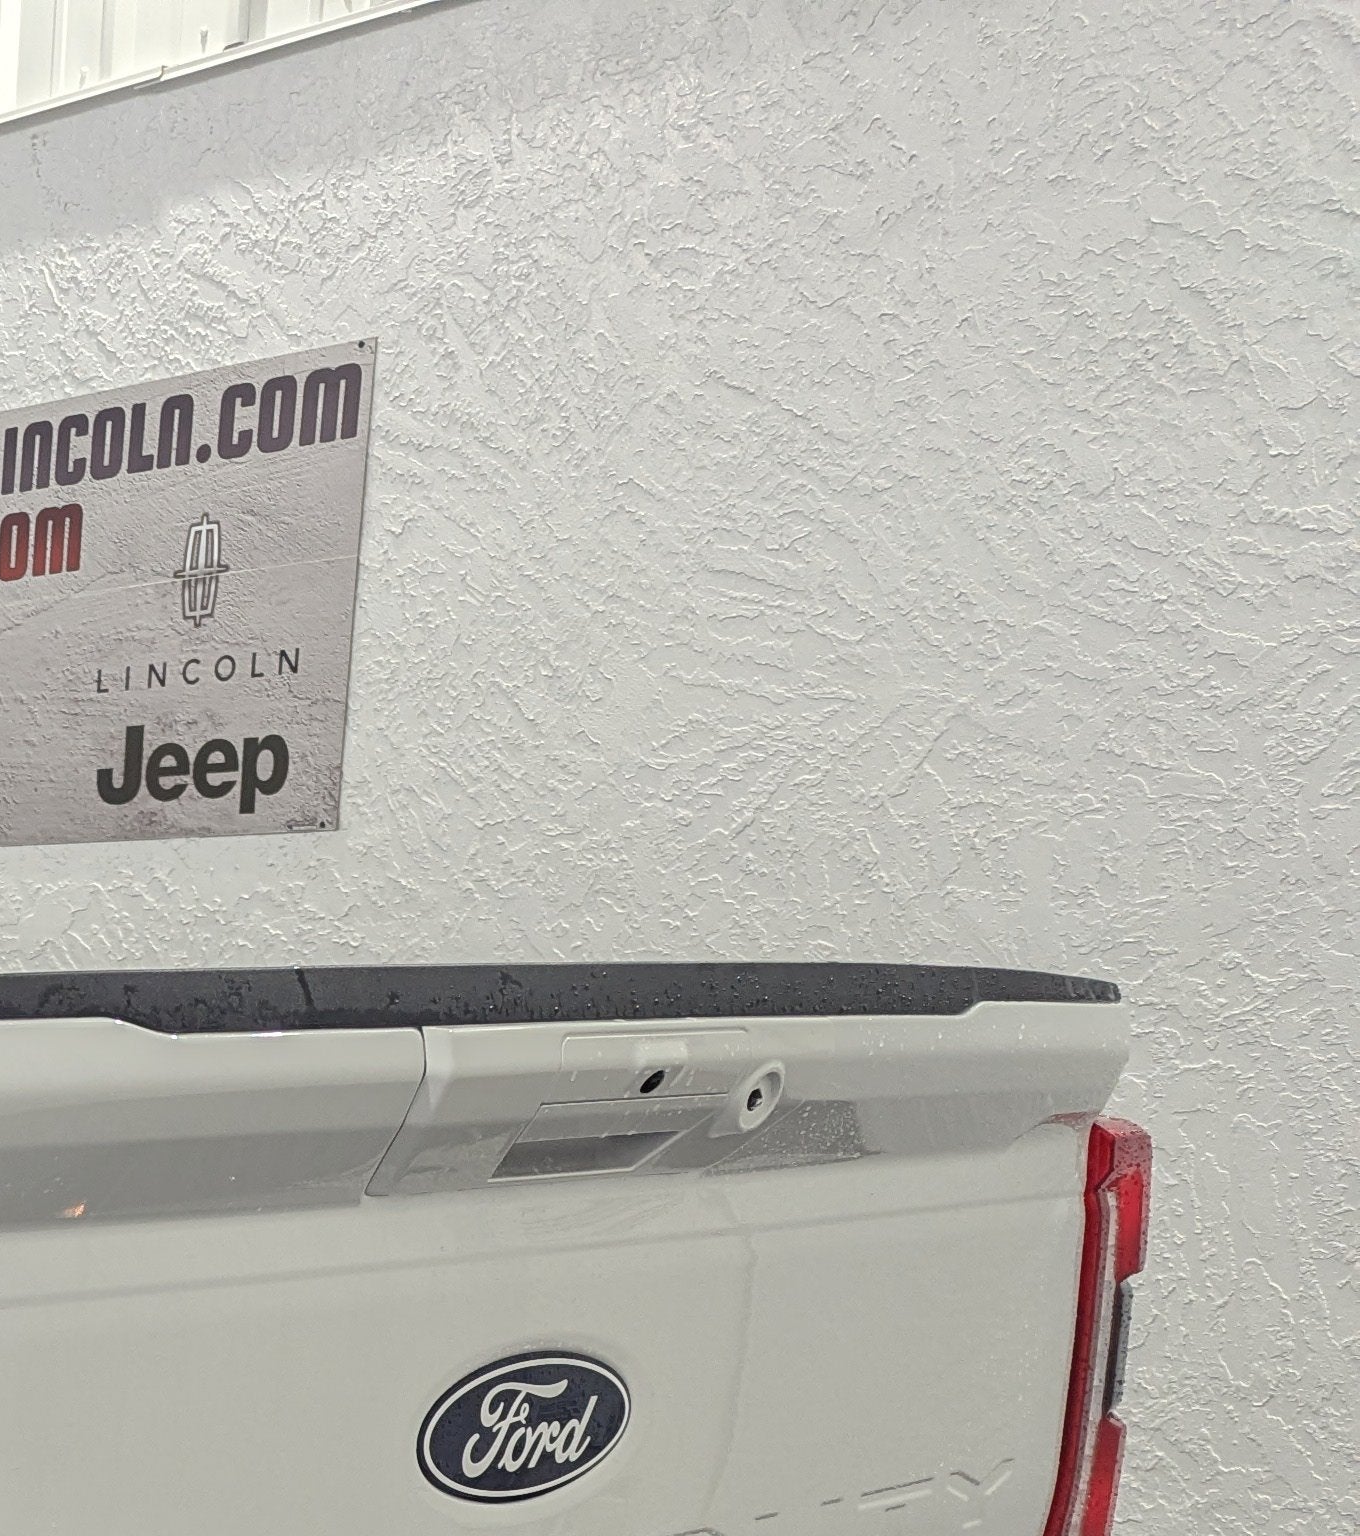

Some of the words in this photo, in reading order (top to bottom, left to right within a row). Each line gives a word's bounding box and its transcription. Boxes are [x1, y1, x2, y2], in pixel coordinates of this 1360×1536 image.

[96, 647, 300, 693] LINCOLN
[96, 724, 290, 815] Jeep
[462, 1378, 598, 1478] Ford
